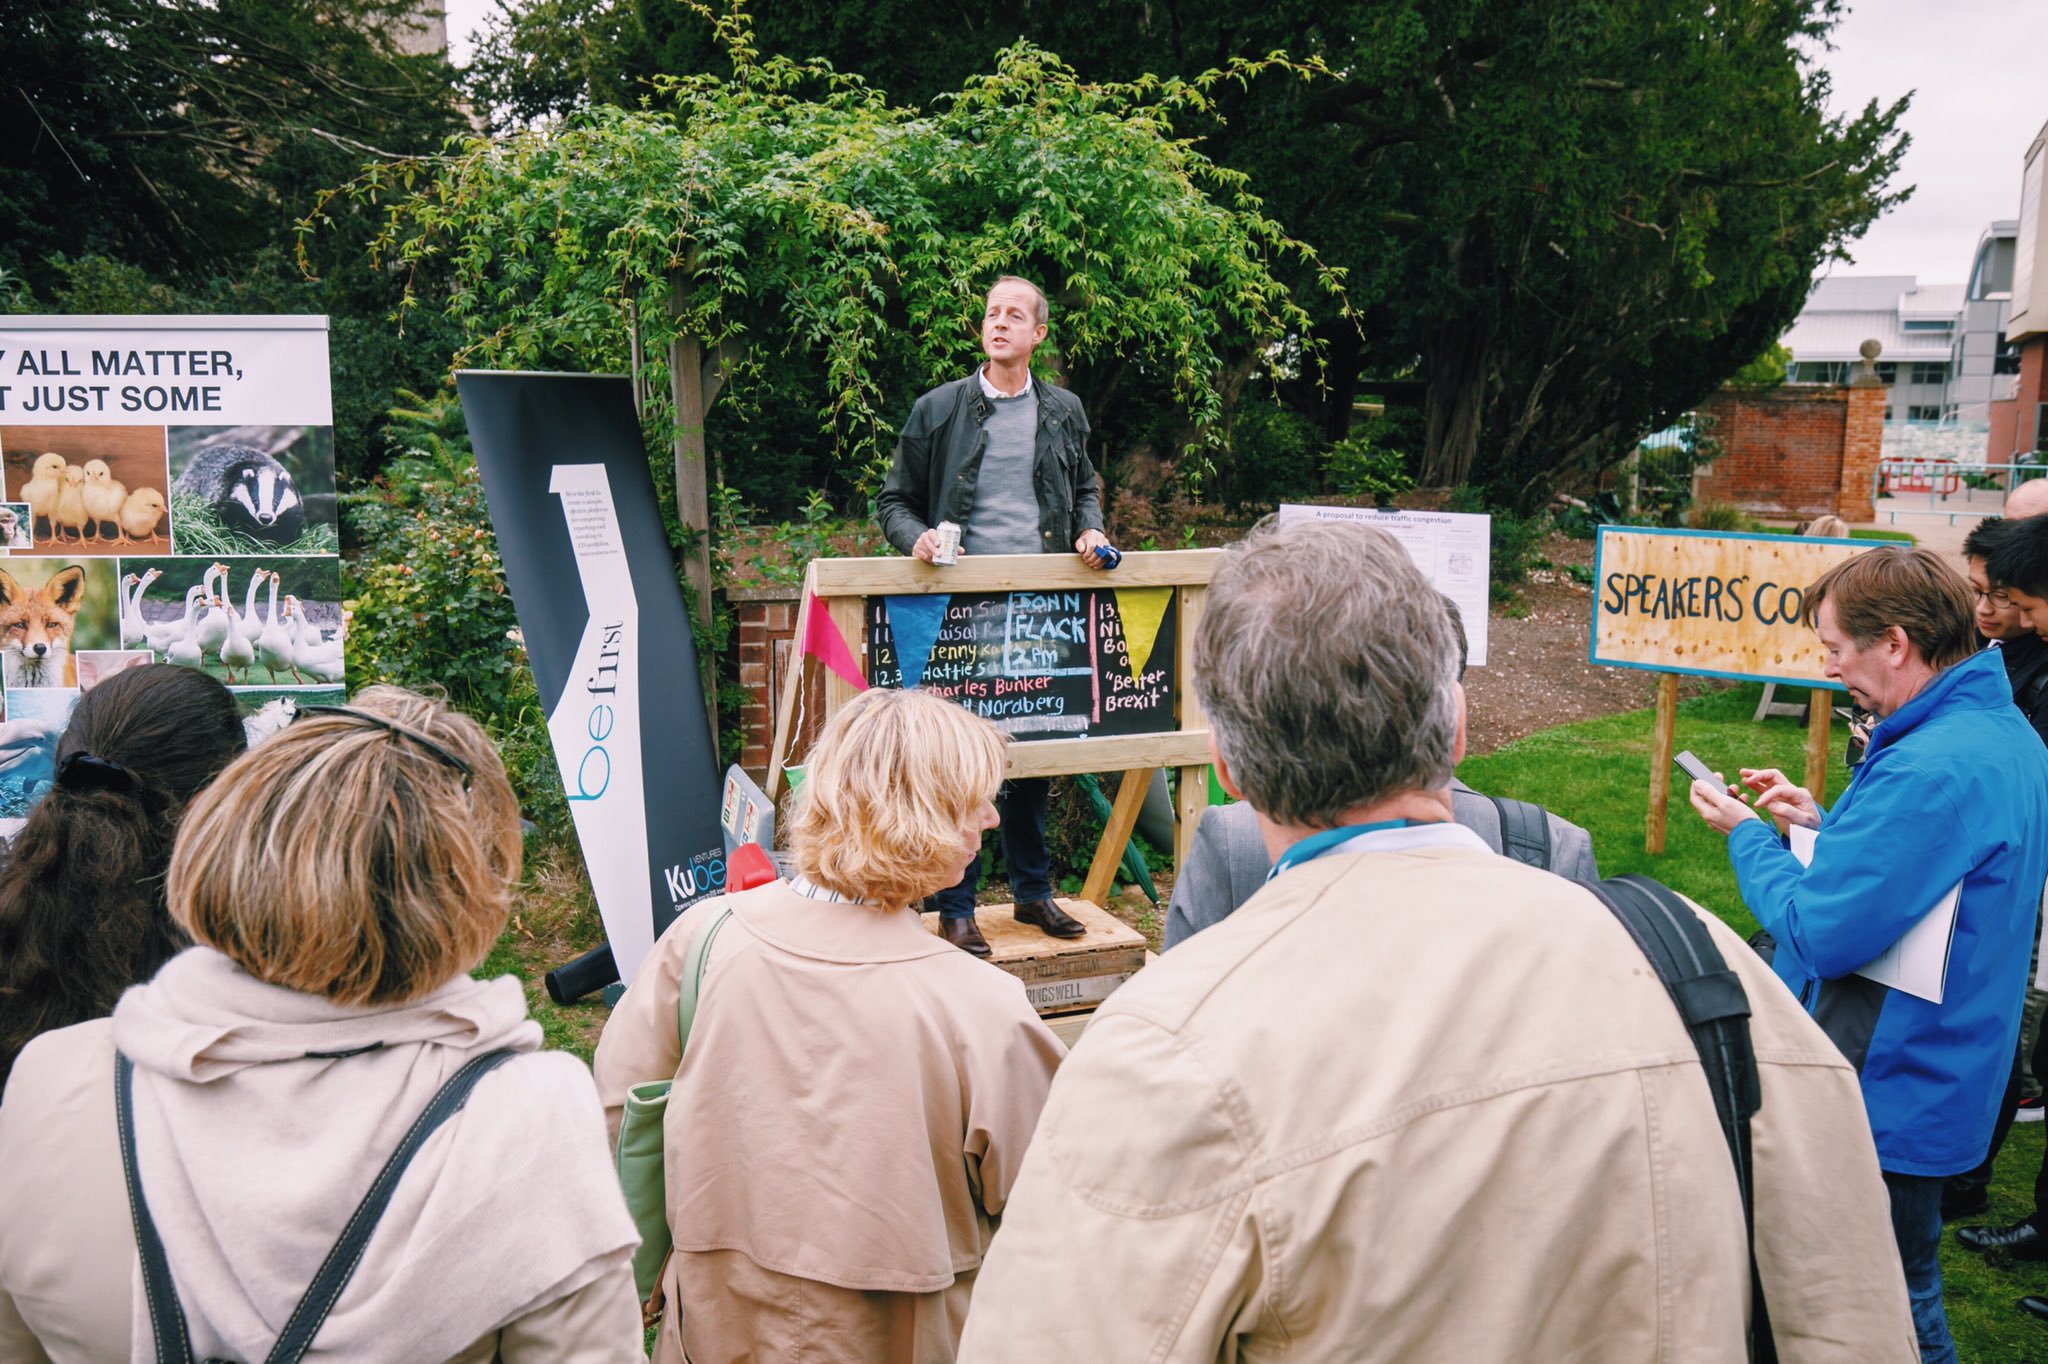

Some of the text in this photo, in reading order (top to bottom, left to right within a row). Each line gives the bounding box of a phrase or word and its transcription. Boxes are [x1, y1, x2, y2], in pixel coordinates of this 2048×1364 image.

[17, 350, 243, 380] ALL MATTER,
[22, 386, 110, 411] JUST
[121, 386, 222, 412] SOME
[1322, 511, 1354, 520] proposal
[1365, 513, 1390, 521] reduce
[1391, 514, 1412, 523] traffic
[1413, 516, 1452, 525] congestion
[1014, 592, 1080, 613] JOHN
[938, 623, 977, 641] aisal
[1016, 614, 1086, 643] FLACK
[1100, 619, 1120, 638] Ni
[928, 645, 977, 665] Jenny
[1012, 647, 1031, 666] 2
[875, 669, 903, 686] 12.3
[922, 661, 973, 681] Hattie
[995, 676, 1053, 697] Bunker
[566, 619, 624, 800] be first
[978, 696, 1065, 717] Nordberg
[692, 847, 722, 864] VENTURES
[664, 857, 726, 903] Kube
[1026, 982, 1083, 1004] RINGSWELL
